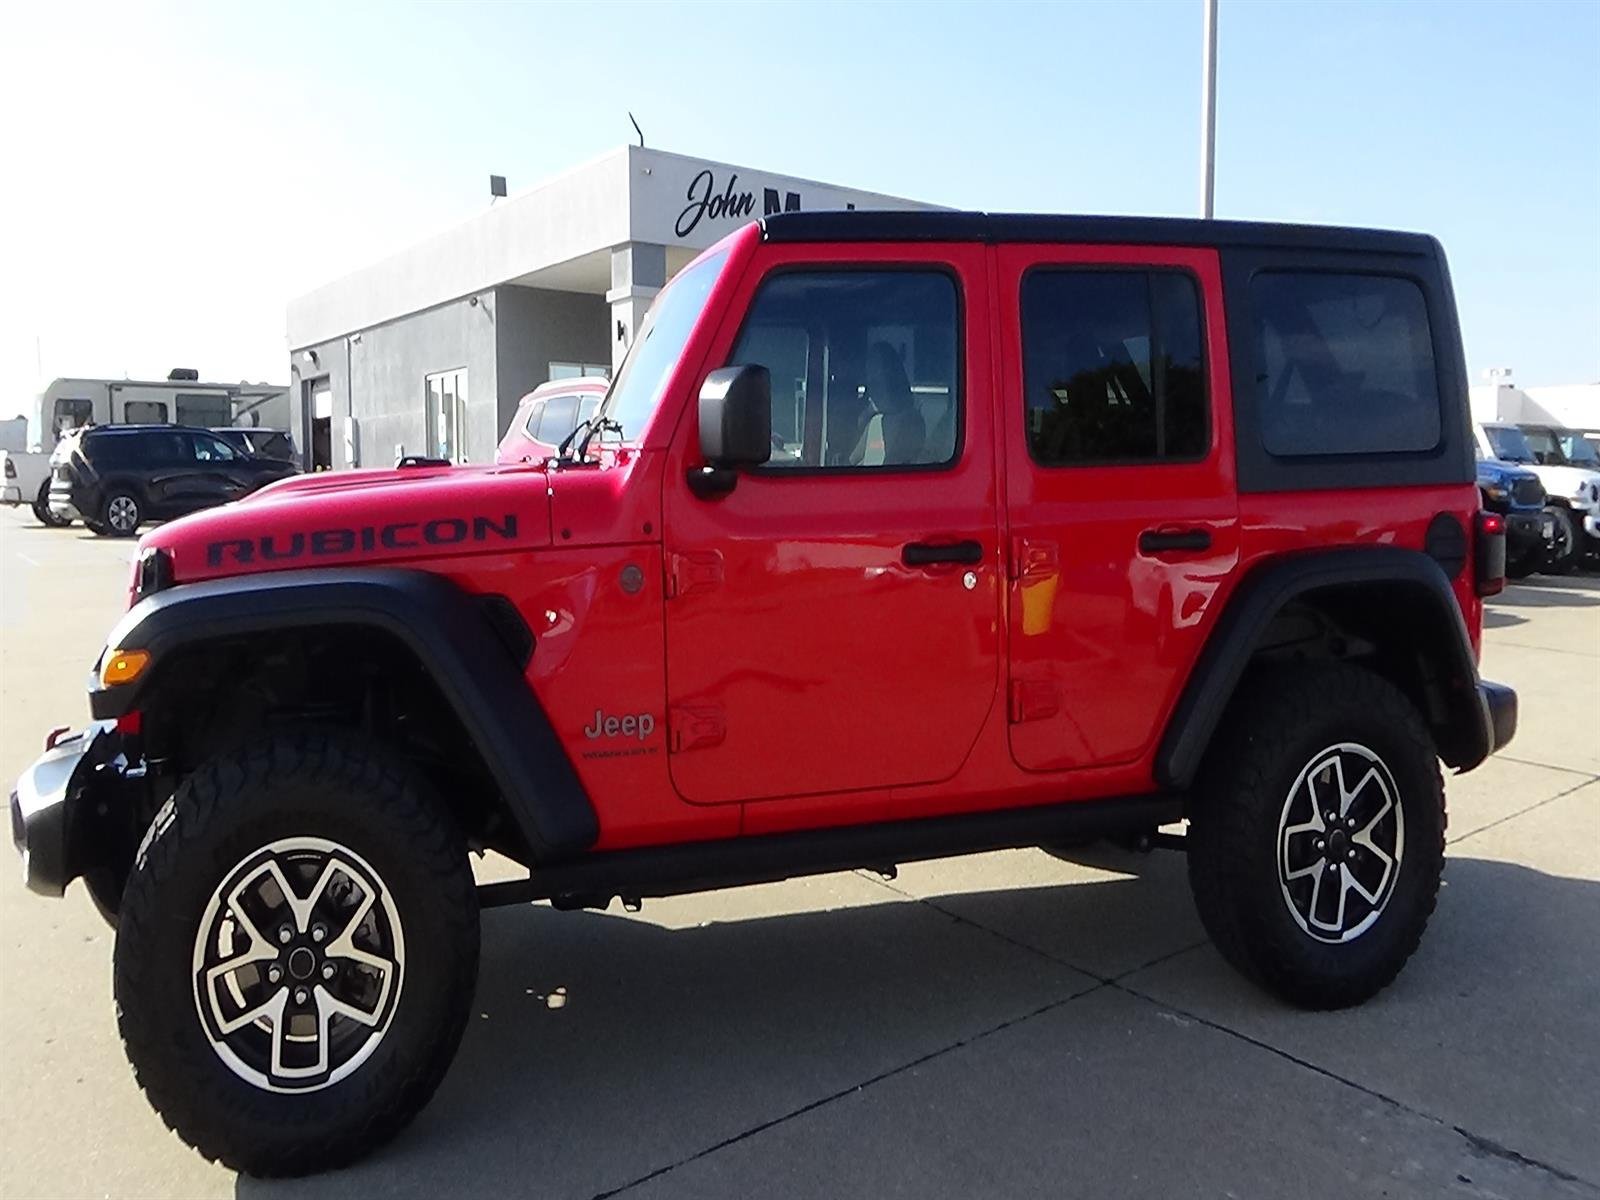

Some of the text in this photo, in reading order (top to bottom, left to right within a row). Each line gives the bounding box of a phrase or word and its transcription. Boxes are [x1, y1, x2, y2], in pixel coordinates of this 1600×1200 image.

[675, 170, 756, 238] John
[206, 514, 518, 568] RUBICON
[584, 710, 655, 740] Jeep
